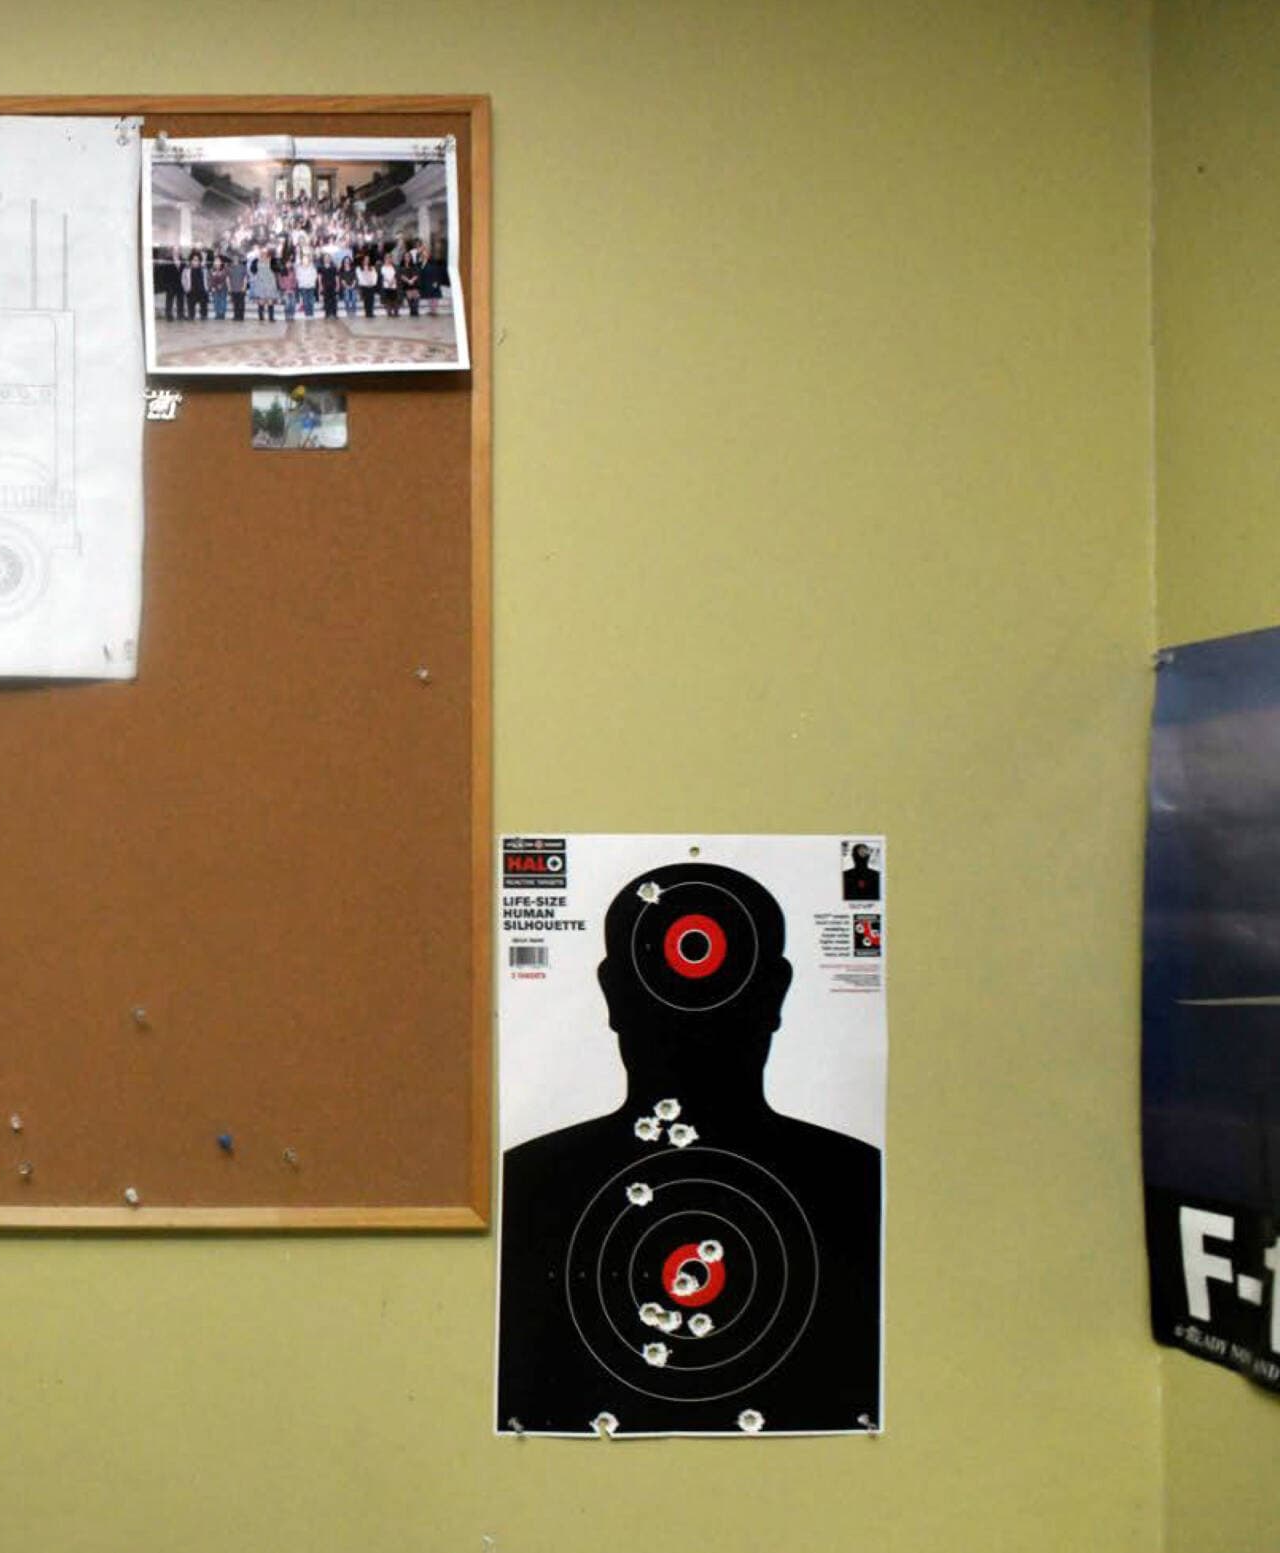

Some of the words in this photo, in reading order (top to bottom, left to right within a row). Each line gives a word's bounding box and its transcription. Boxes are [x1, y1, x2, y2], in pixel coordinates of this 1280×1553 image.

[506, 854, 563, 872] HALO
[503, 895, 567, 907] LIFE-SIZE
[503, 908, 555, 919] HUMAN
[503, 920, 586, 931] SILHOUETTE
